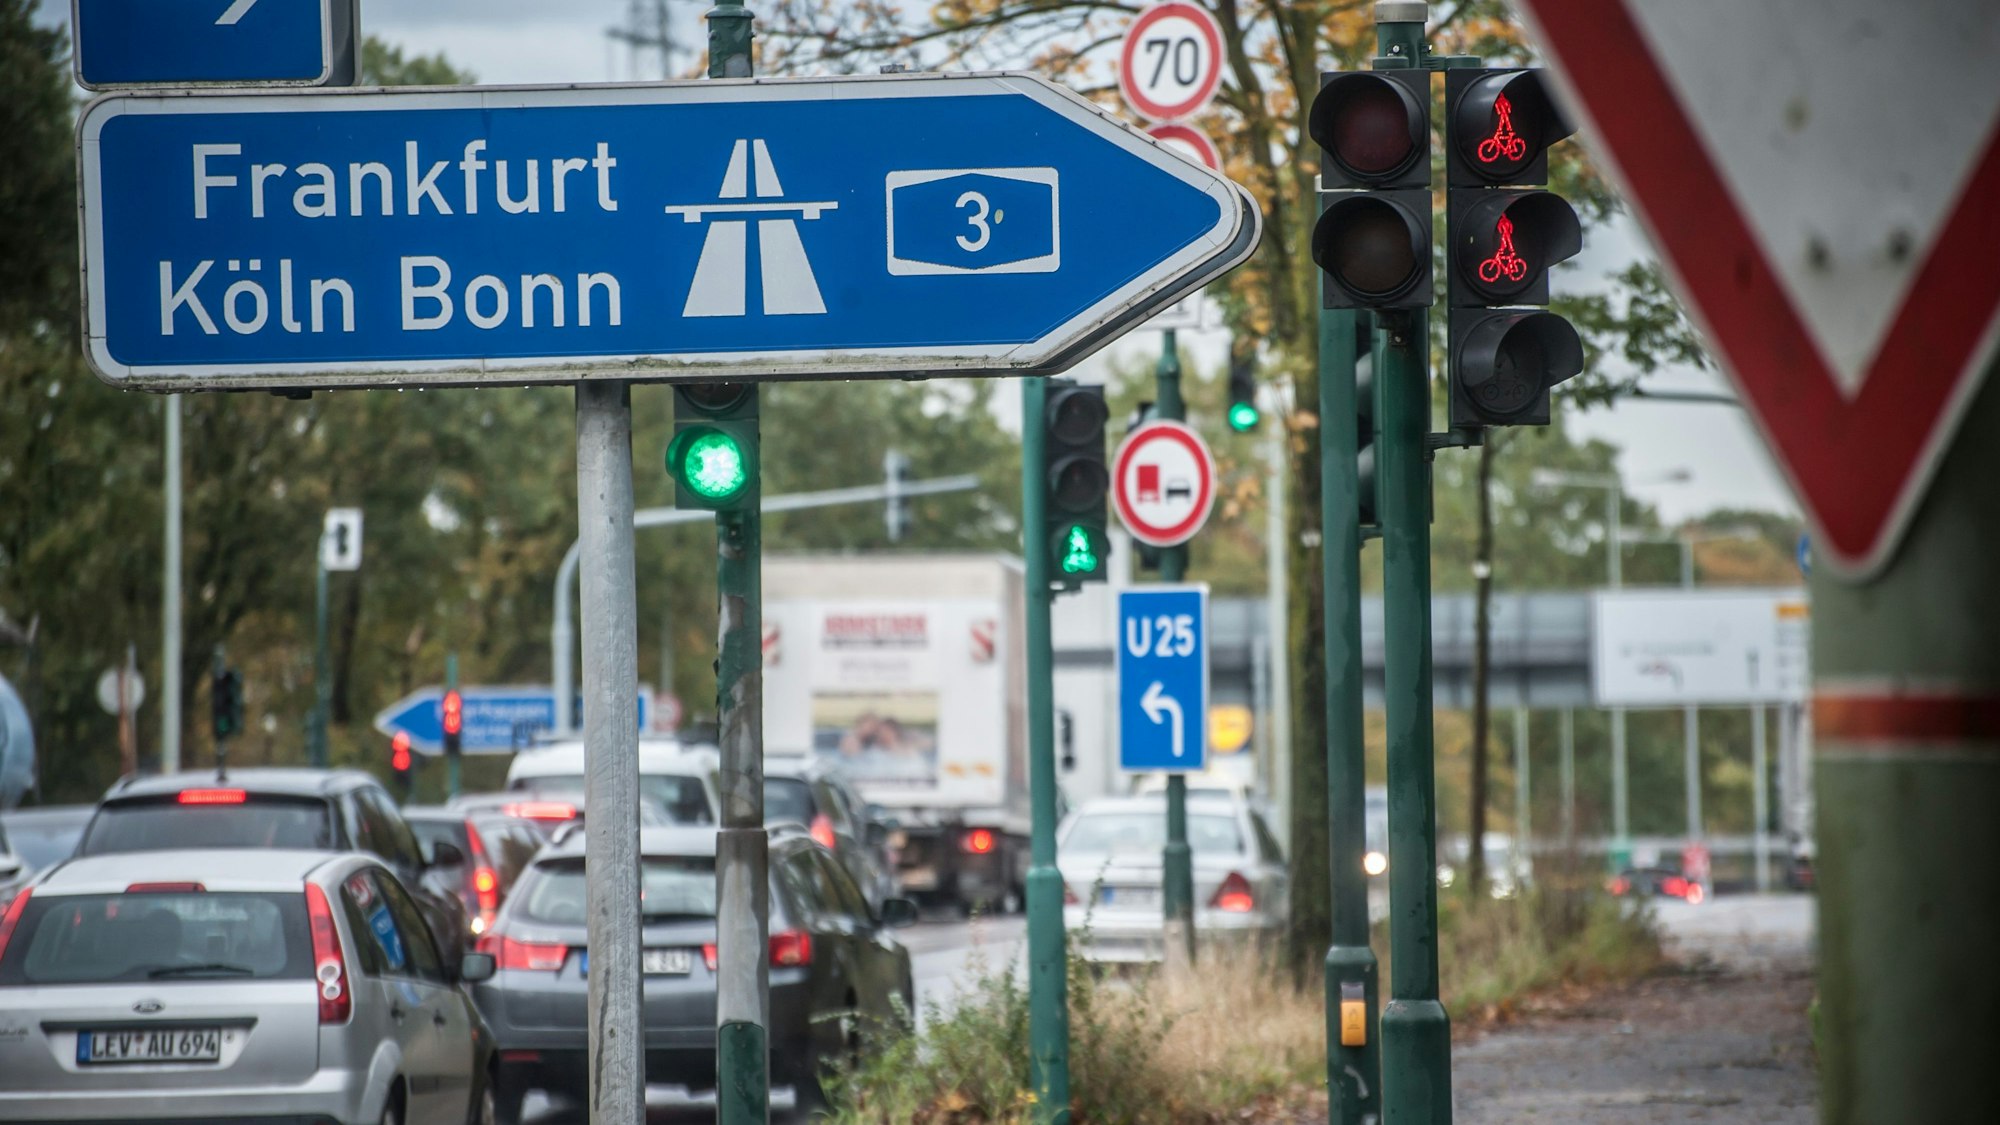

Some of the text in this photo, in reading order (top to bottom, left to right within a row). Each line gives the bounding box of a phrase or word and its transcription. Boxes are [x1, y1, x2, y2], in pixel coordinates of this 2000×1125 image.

[1146, 38, 1199, 87] 70
[193, 140, 618, 219] Frankfurt
[954, 191, 990, 252] 3
[159, 256, 621, 335] Köln Bonn
[92, 1031, 216, 1058] LEV AU 694
